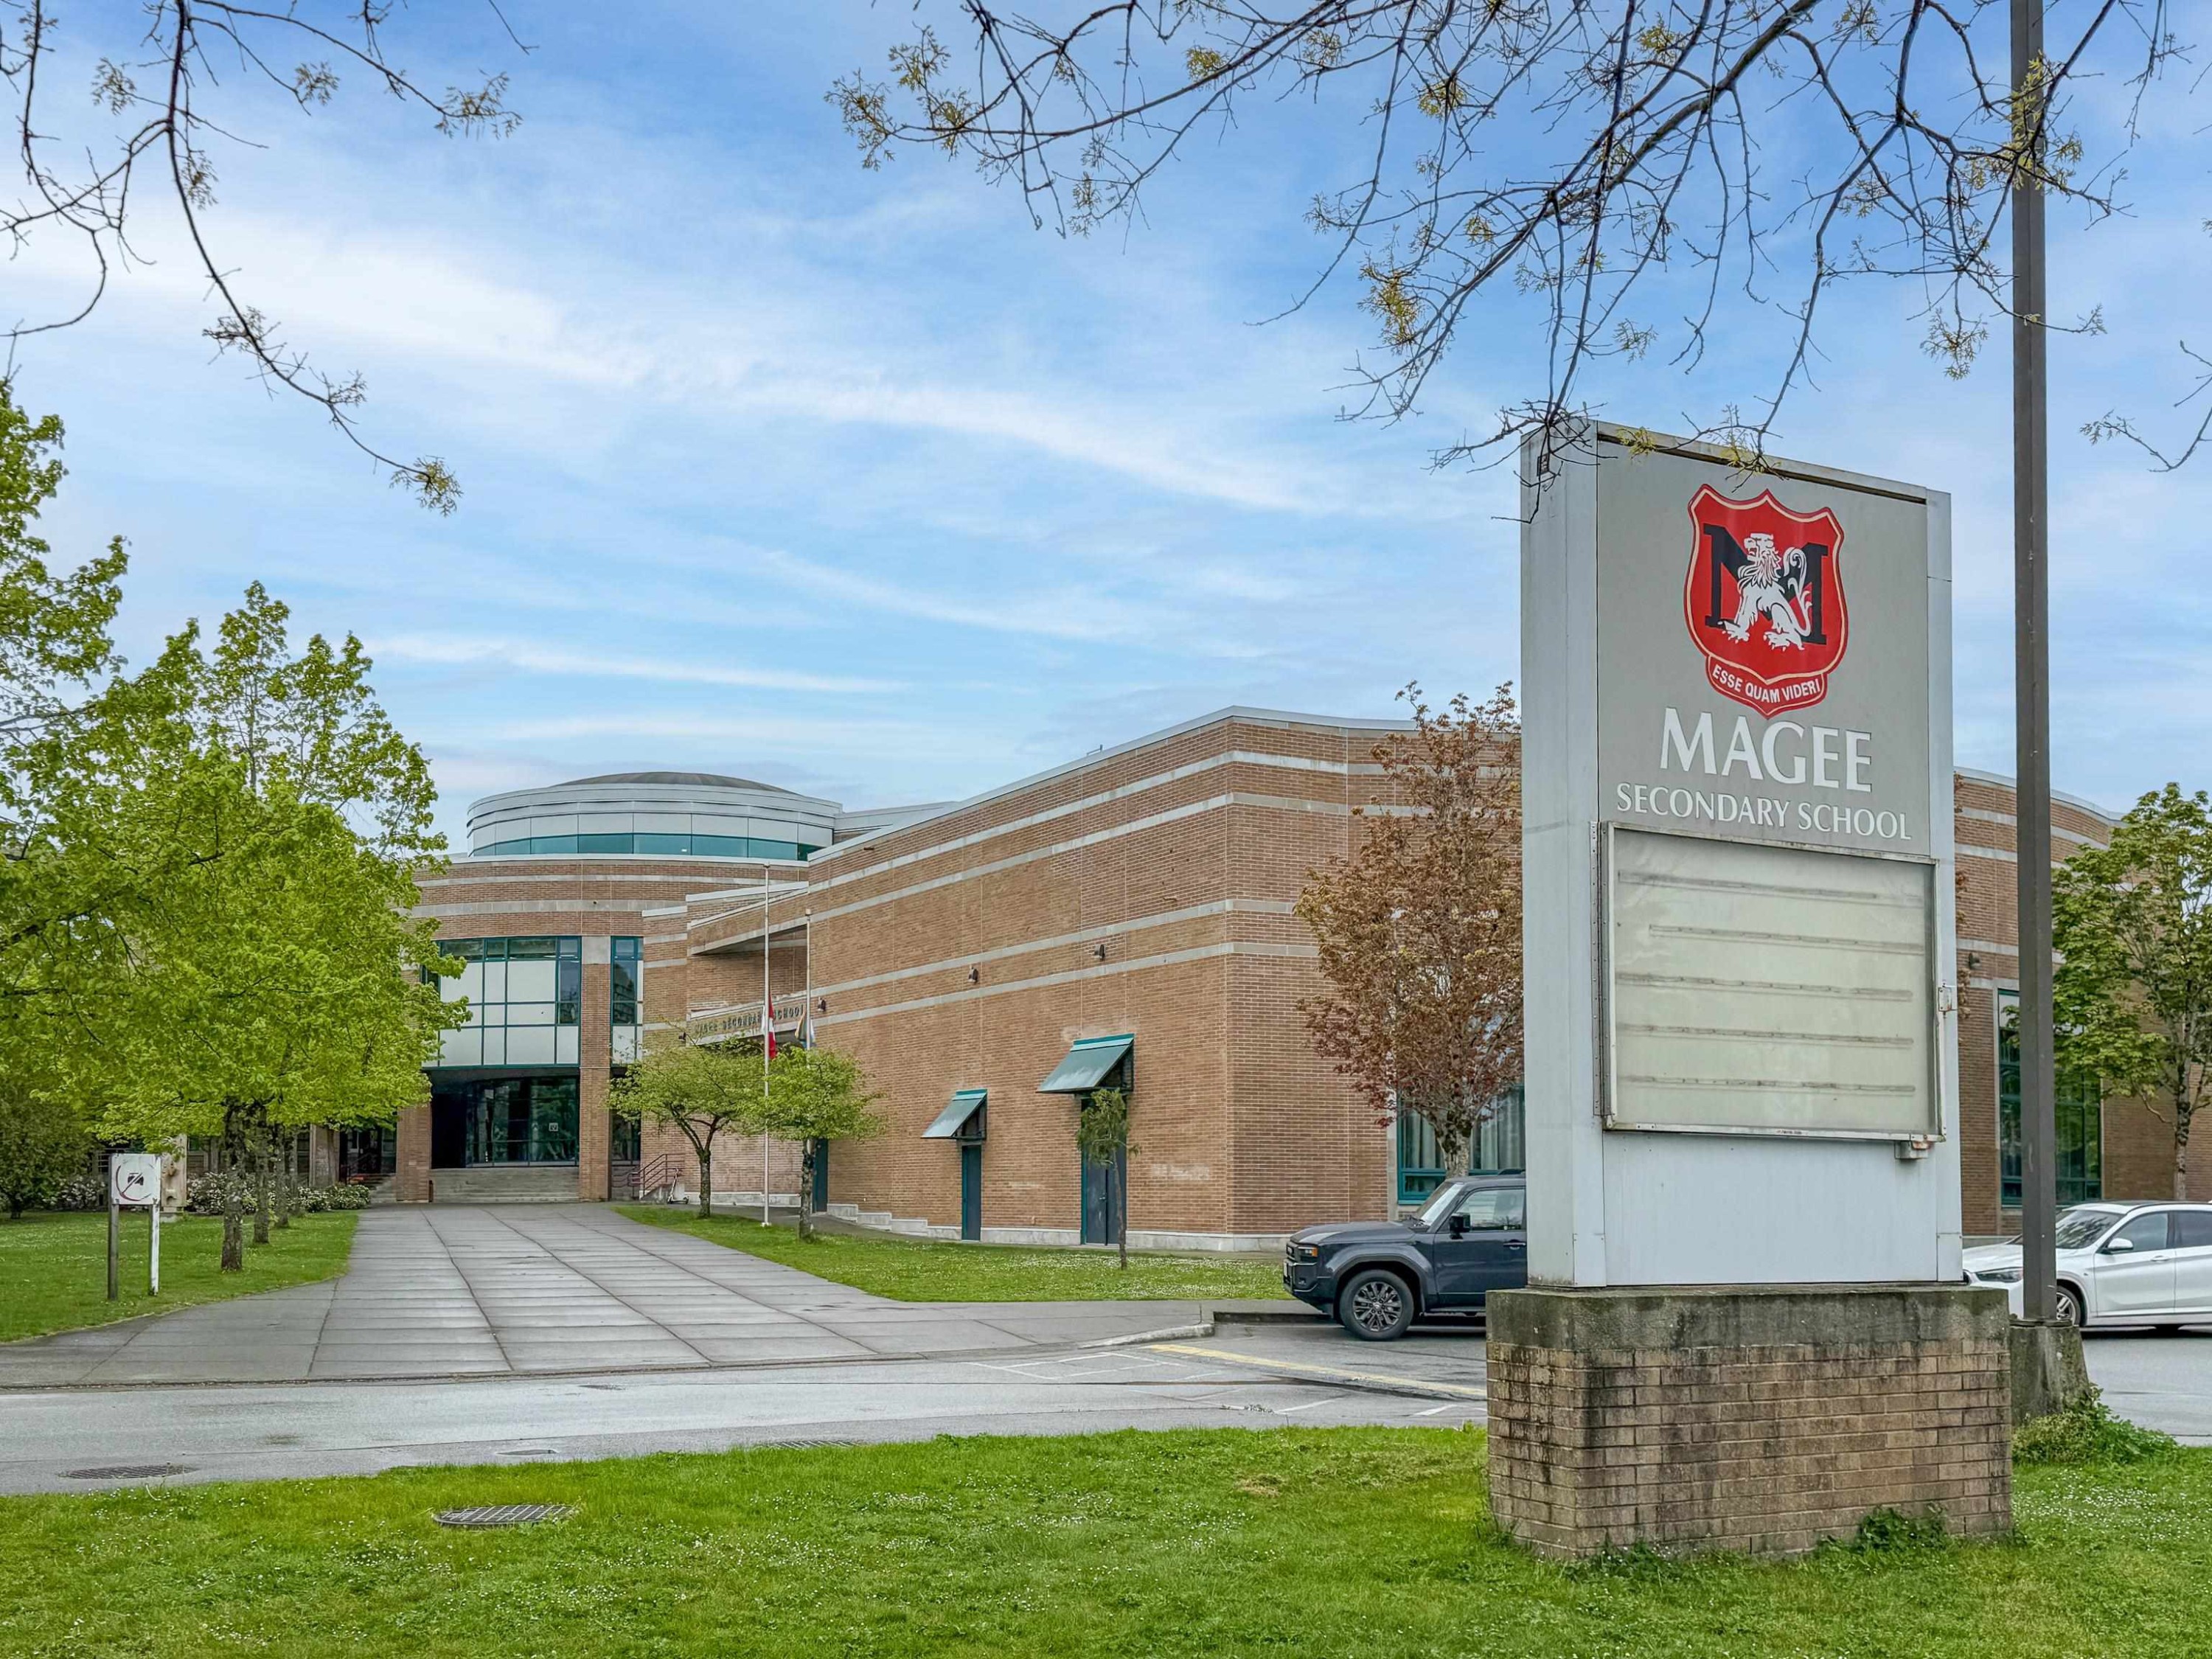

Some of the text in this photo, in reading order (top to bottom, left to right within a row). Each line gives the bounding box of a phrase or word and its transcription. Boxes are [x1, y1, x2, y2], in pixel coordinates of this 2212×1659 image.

[1712, 664, 1820, 703] ESSE QUAM VIDERI
[1660, 707, 1872, 793] MAGEE
[1617, 782, 1912, 840] SECONDARY SCHOOL
